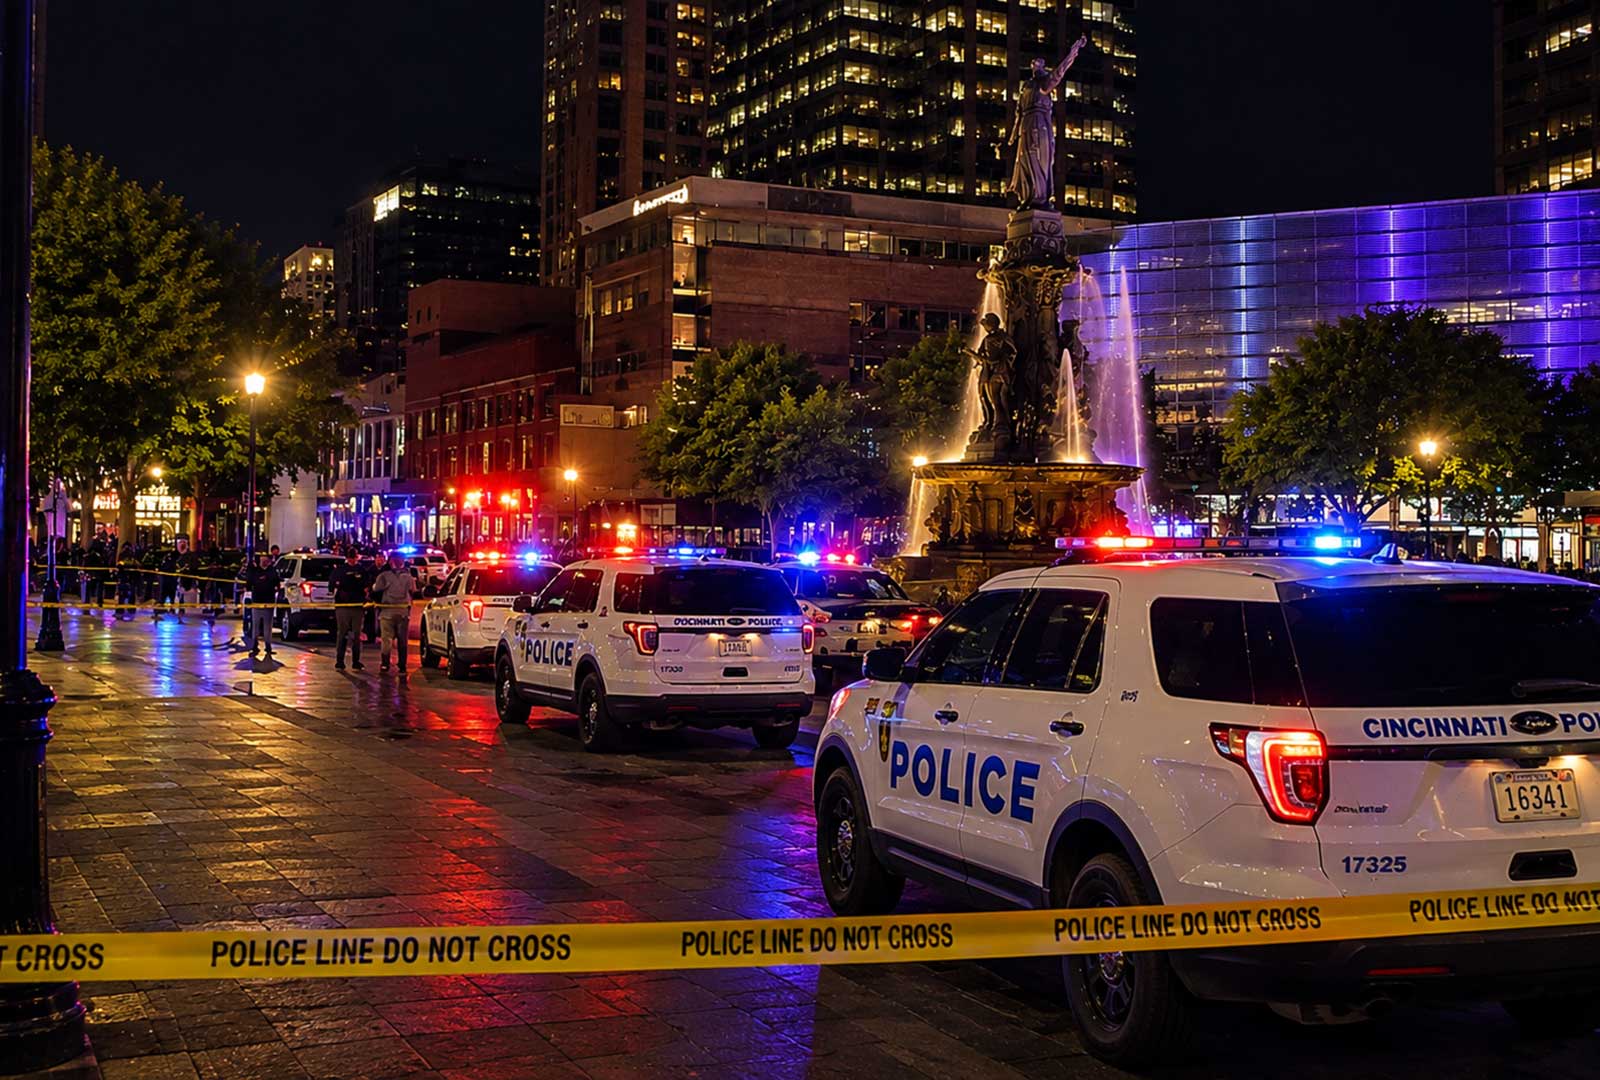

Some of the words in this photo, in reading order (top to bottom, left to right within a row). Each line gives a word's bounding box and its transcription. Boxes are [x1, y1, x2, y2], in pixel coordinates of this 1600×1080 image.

[525, 639, 574, 666] POLICE
[1363, 715, 1508, 738] CINCINNATI
[890, 740, 1041, 823] POLICE
[1505, 784, 1568, 812] 16341
[1342, 856, 1407, 874] 17325
[1409, 897, 1480, 922] POLICE
[1484, 894, 1529, 918] LINE
[1531, 892, 1559, 914] DO
[1054, 915, 1126, 942] POLICE
[1132, 913, 1176, 938] LINE
[1181, 911, 1208, 936] DO
[1214, 910, 1252, 934] NOT
[1257, 906, 1321, 932] CROSS
[211, 939, 307, 967] POLICE
[316, 937, 374, 966] LINE
[383, 936, 419, 963] DO
[428, 935, 480, 963] NOT
[487, 934, 571, 961] CROSS
[681, 930, 754, 957] POLICE
[760, 928, 804, 954] LINE
[809, 926, 836, 953] DO
[843, 925, 882, 951] NOT
[888, 923, 953, 949] CROSS
[16, 943, 104, 972] CROSS
